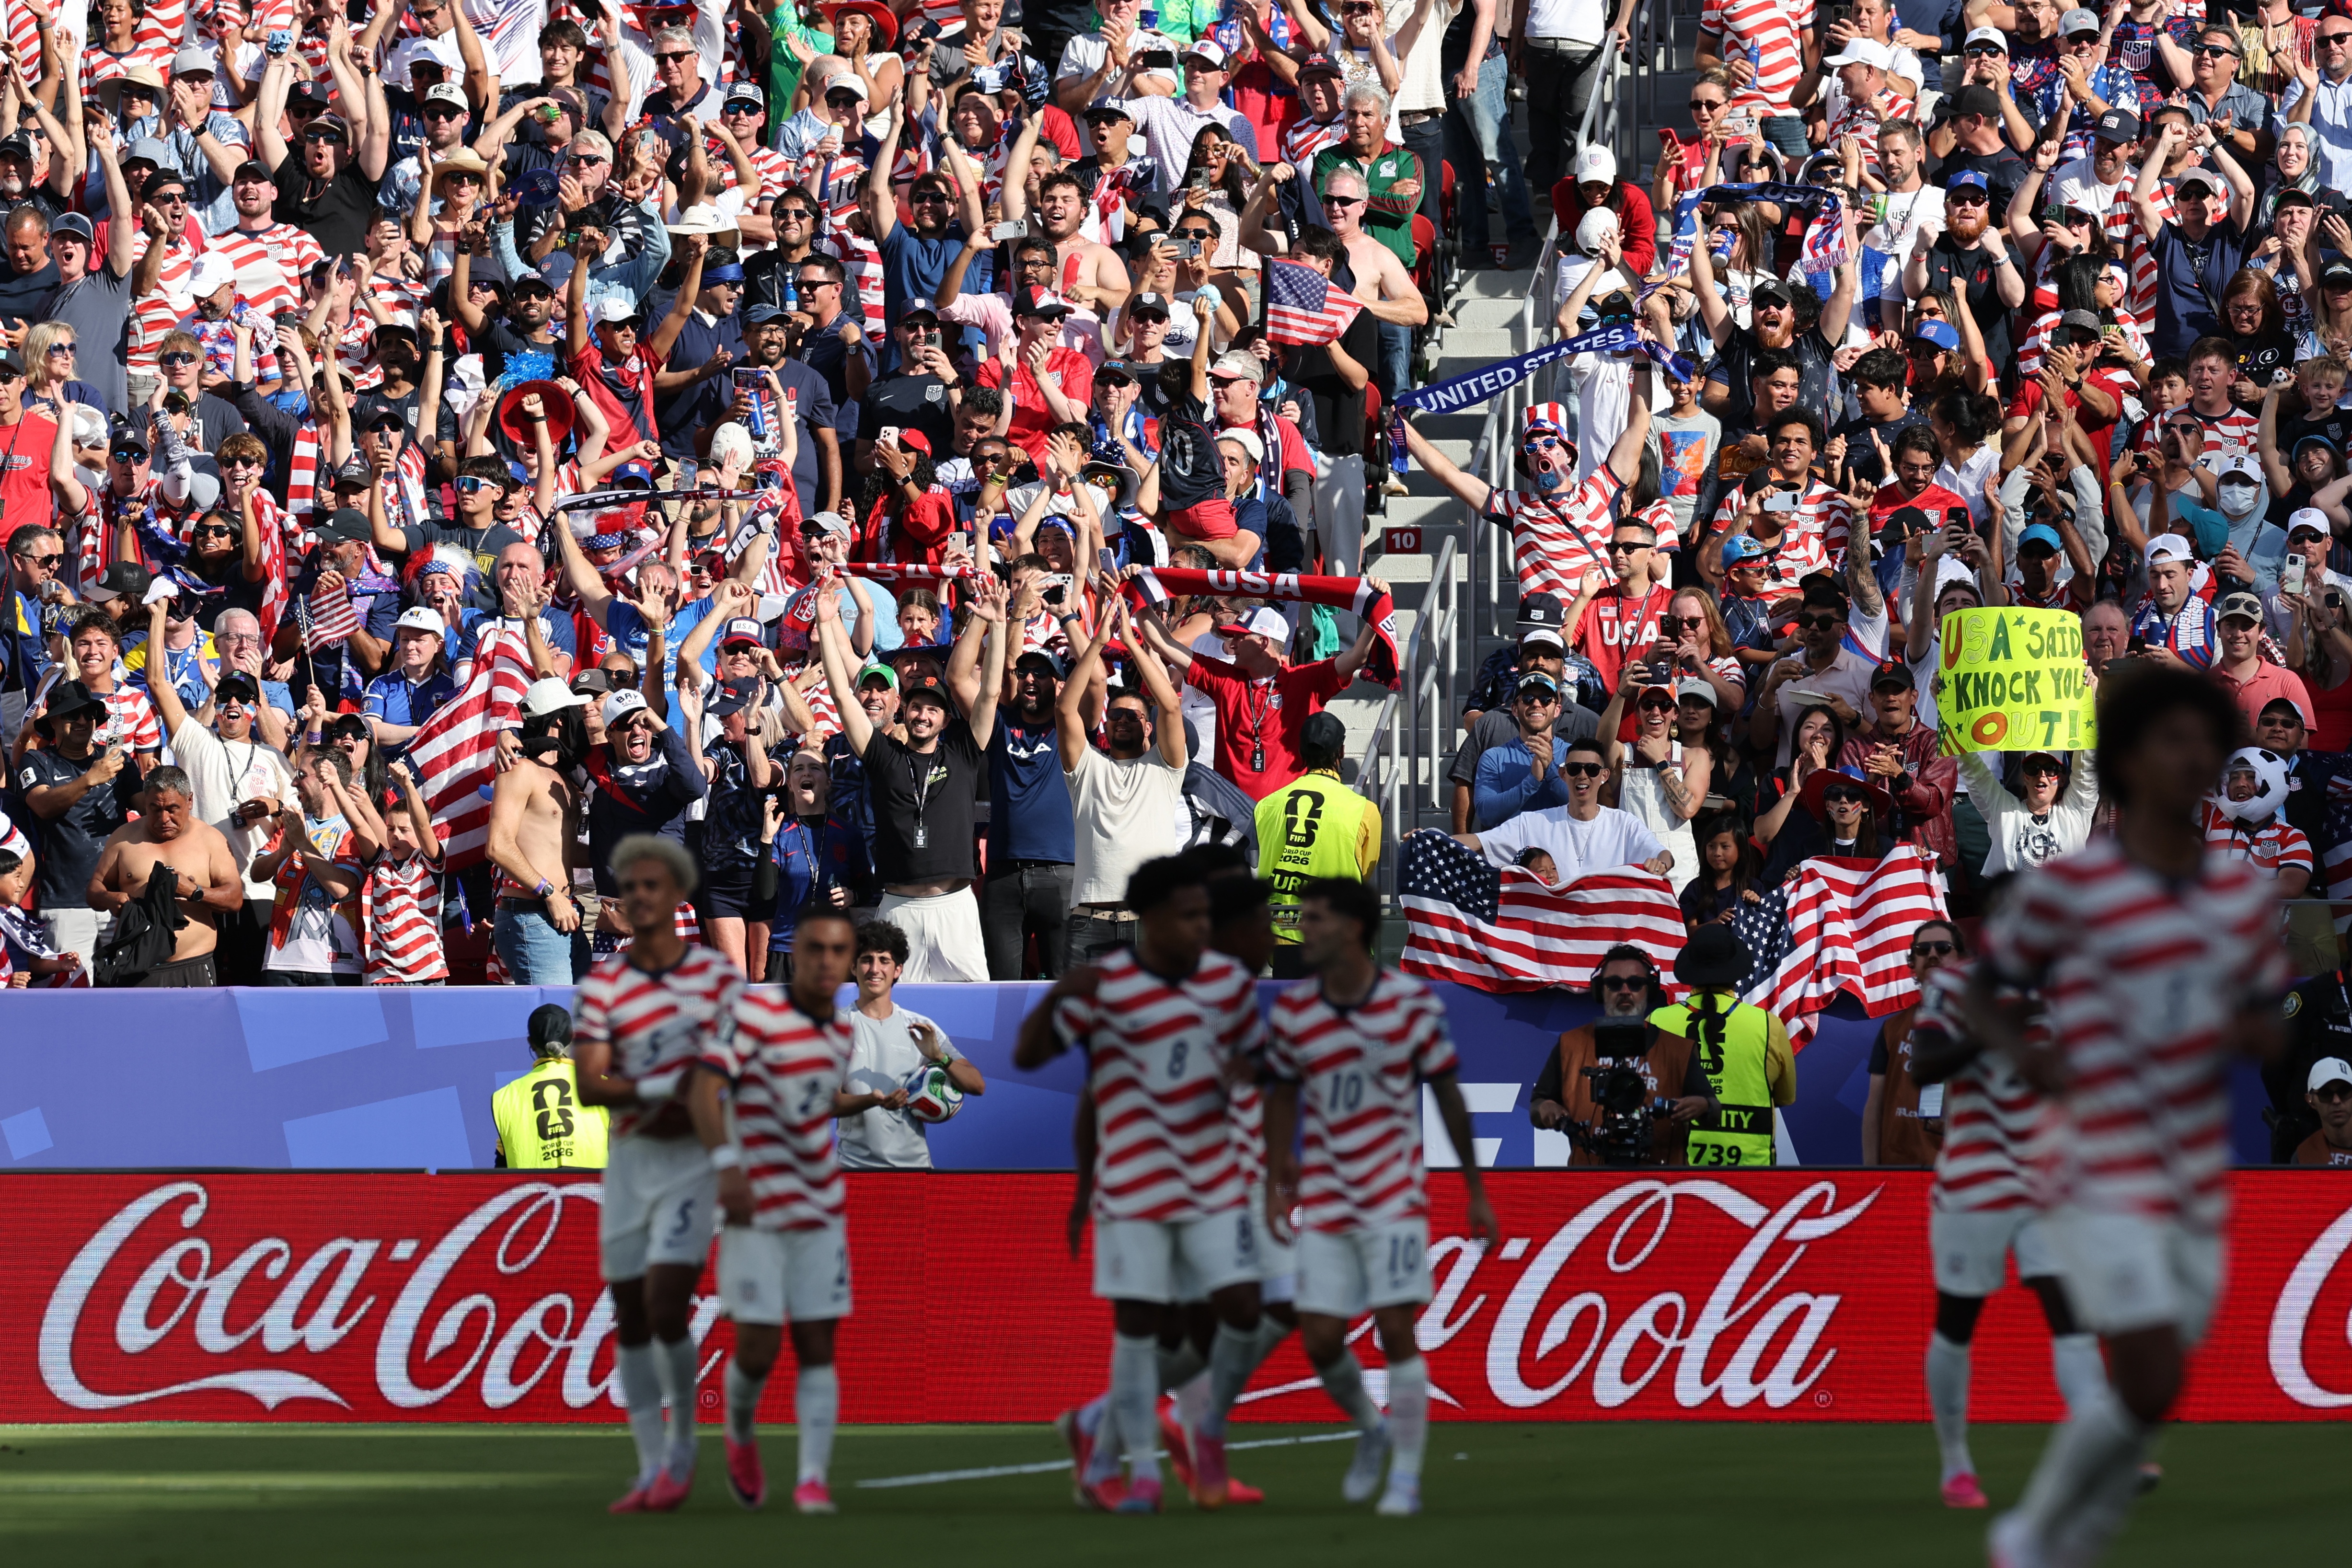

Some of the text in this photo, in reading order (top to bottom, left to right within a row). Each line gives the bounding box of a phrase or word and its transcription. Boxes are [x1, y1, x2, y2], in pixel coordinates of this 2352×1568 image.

[2123, 41, 2150, 53] USA
[1330, 122, 1344, 130] USA
[536, 177, 549, 196] ULTRA
[1892, 210, 1912, 221] USA
[2327, 265, 2350, 274] ARGENTINA
[868, 272, 881, 295] 2
[1415, 327, 1626, 413] UNITED STATES
[1664, 441, 1701, 458] CONVERSE
[1722, 458, 1733, 467] 19
[1666, 470, 1676, 480] ALL
[1570, 505, 1582, 513] USA
[1392, 532, 1415, 549] 10
[1795, 562, 1806, 570] USA
[1207, 569, 1303, 597] USA
[736, 623, 754, 632] U.S.A.
[2178, 597, 2192, 651] ZEGOVINA
[2191, 595, 2204, 647] BOSNIA AND
[1603, 620, 1659, 646] USA
[1944, 611, 2081, 670] USA SAID
[617, 692, 638, 703] BAY
[1954, 668, 2085, 714] KNOCK YOU
[1971, 709, 2081, 749] OUT!
[1007, 743, 1051, 759] USA
[1906, 762, 1918, 771] USA
[252, 775, 265, 785] USA
[1290, 834, 1306, 843] FIFA
[2015, 826, 2063, 859] USA
[2262, 840, 2277, 848] USA
[402, 866, 412, 875] USA
[1167, 1041, 1187, 1079] 8
[1329, 1074, 1361, 1112] 10
[548, 1124, 565, 1135] FIFA
[541, 1141, 562, 1152] WORLD
[542, 1147, 574, 1161] 2026
[1692, 1143, 1741, 1165] 739
[673, 1199, 695, 1236] 5
[1236, 1217, 1255, 1253] 8
[1388, 1235, 1422, 1273] 10
[38, 1181, 724, 1411] Coca-Co
